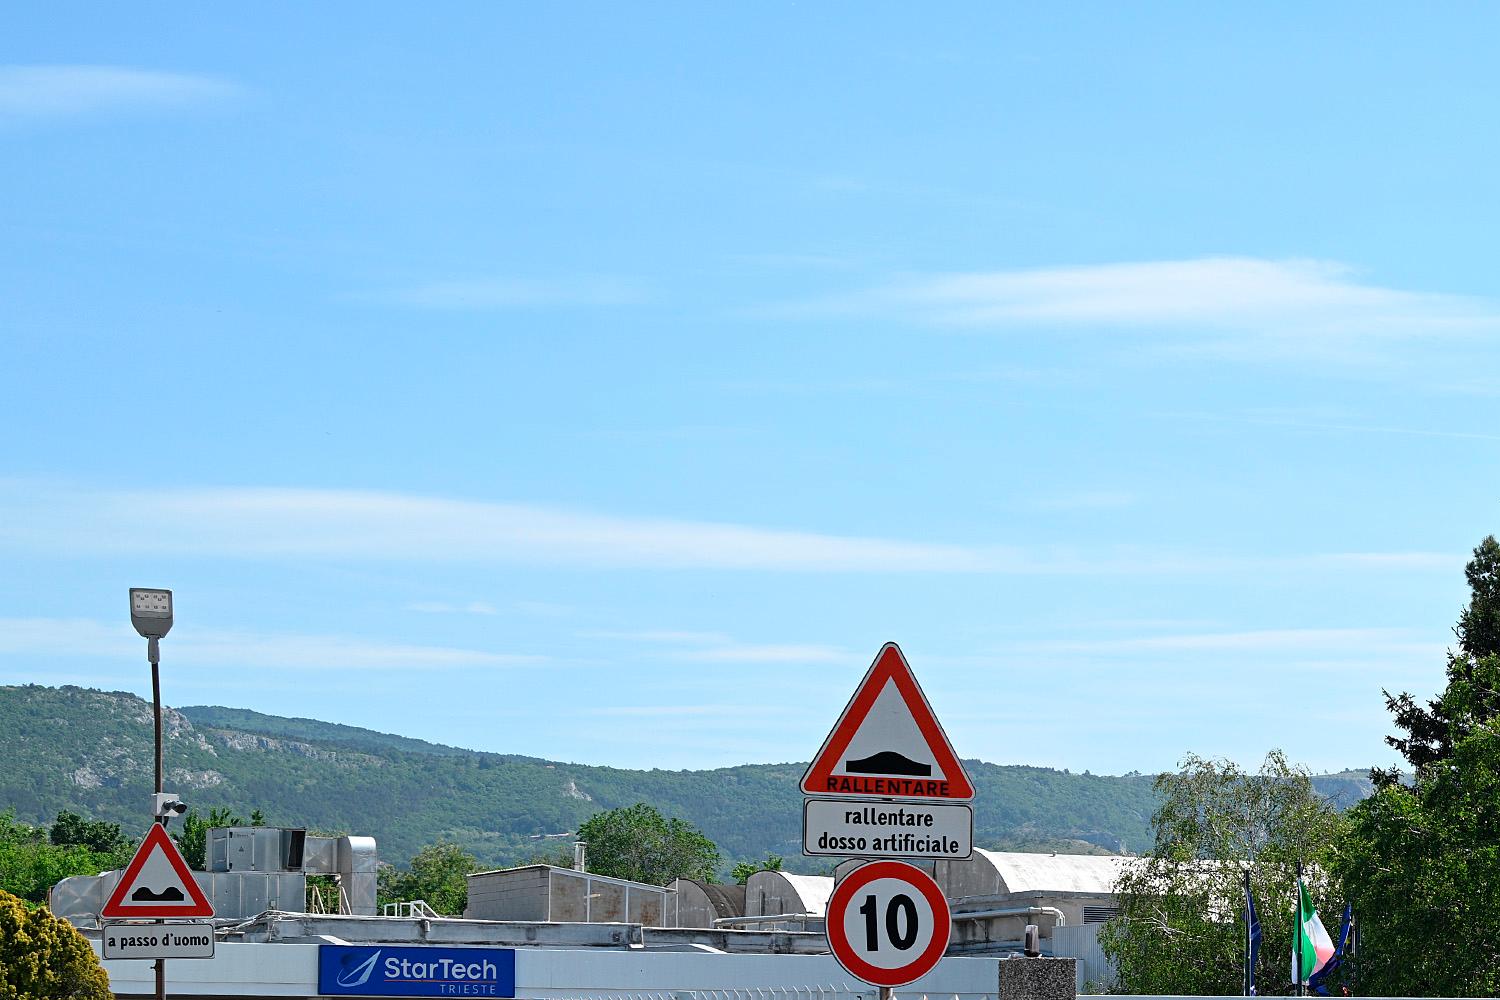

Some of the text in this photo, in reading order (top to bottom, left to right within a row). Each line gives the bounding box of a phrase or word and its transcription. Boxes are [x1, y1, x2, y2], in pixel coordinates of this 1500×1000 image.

[827, 777, 950, 796] RALLENTARE
[845, 808, 933, 827] rallentare
[818, 832, 959, 854] dosso artificiale
[860, 893, 919, 952] 10
[108, 933, 209, 950] a passo d'uomo
[384, 957, 497, 980] StarTech
[440, 985, 497, 994] TRIESTE
